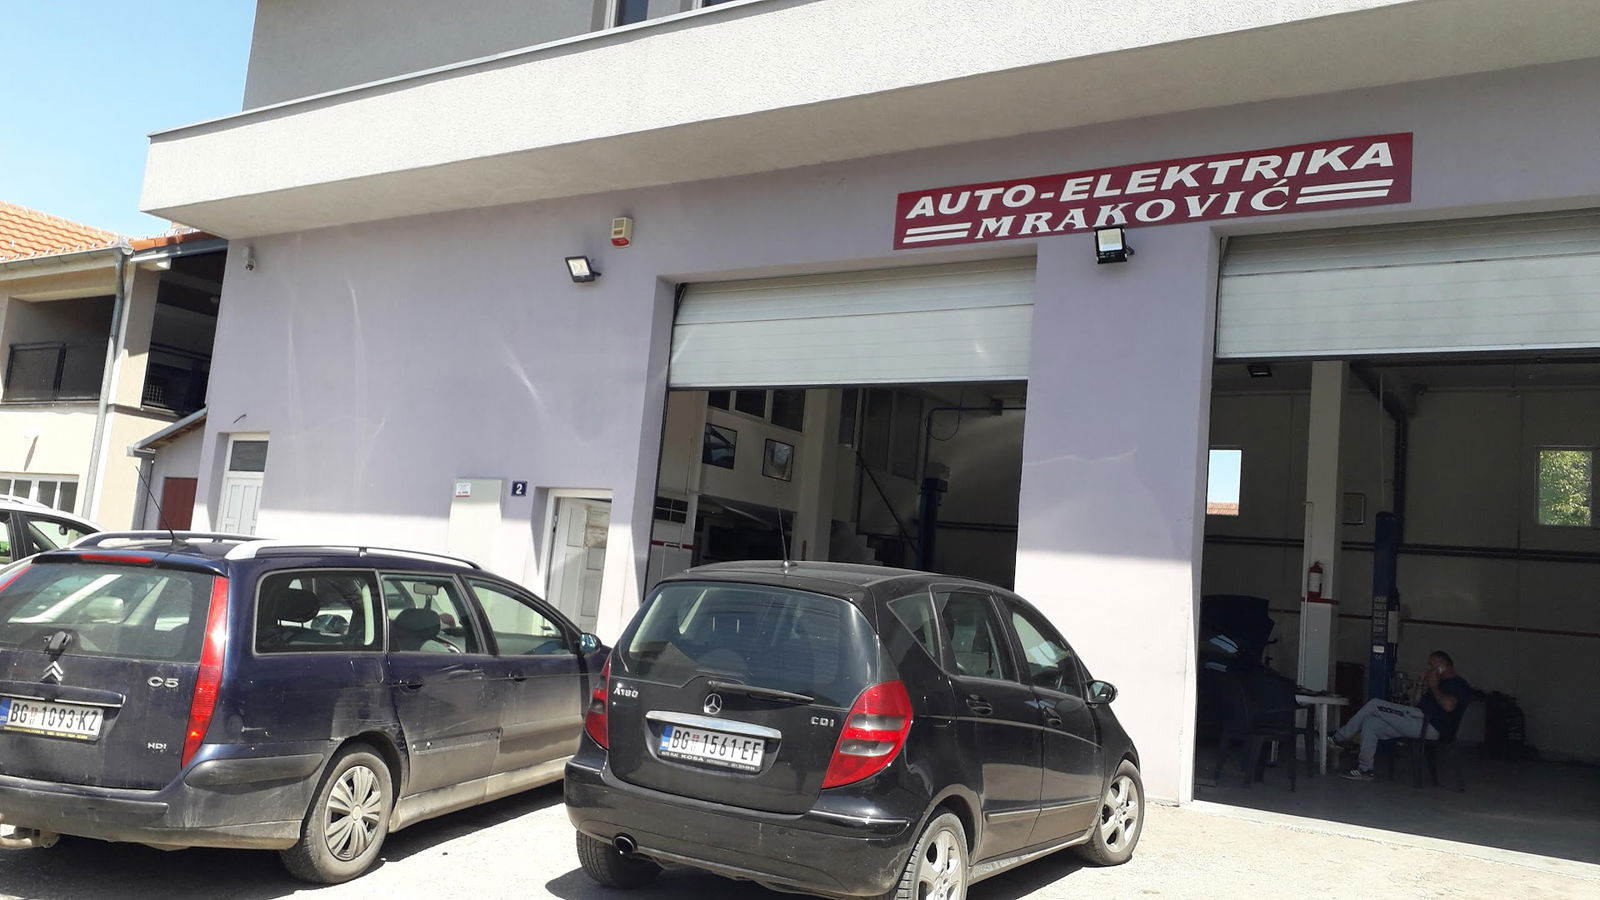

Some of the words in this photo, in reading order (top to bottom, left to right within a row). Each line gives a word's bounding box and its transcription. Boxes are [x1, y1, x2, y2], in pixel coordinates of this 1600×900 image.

[905, 141, 1394, 219] AUTO-ELEKTRIKA
[974, 178, 1290, 239] MRAKOVIĆ
[515, 483, 523, 494] 2
[147, 676, 179, 688] C5
[10, 703, 29, 724] BG
[811, 716, 835, 727] CDI
[672, 729, 690, 749] BG
